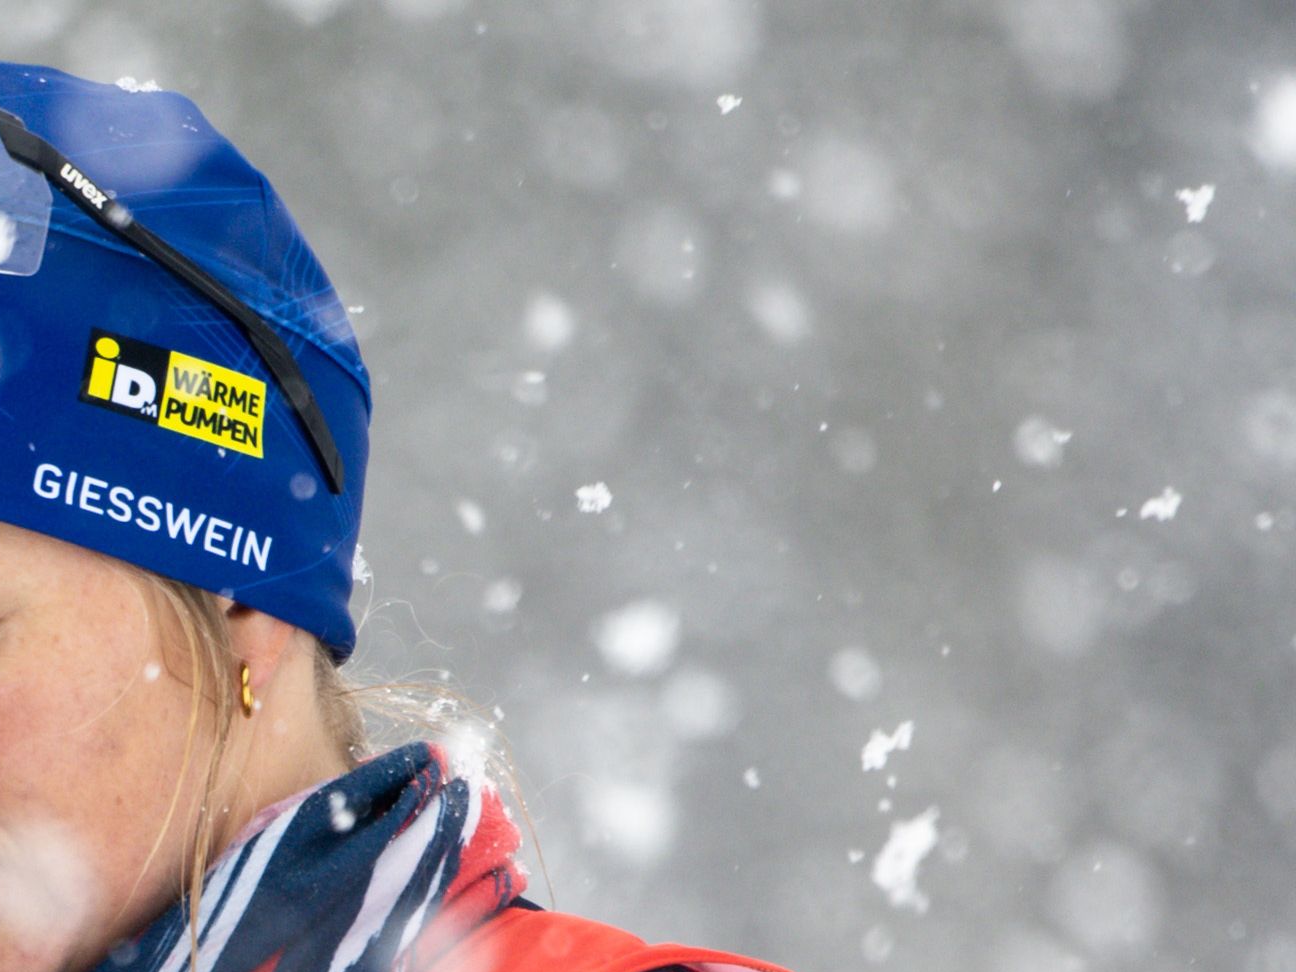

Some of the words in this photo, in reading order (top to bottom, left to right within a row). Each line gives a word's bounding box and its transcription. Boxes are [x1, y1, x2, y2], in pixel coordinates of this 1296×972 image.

[60, 163, 108, 210] uvex
[172, 366, 261, 418] WÄRME
[165, 397, 258, 448] PUMPEN
[32, 463, 273, 572] GIESSWEIN
